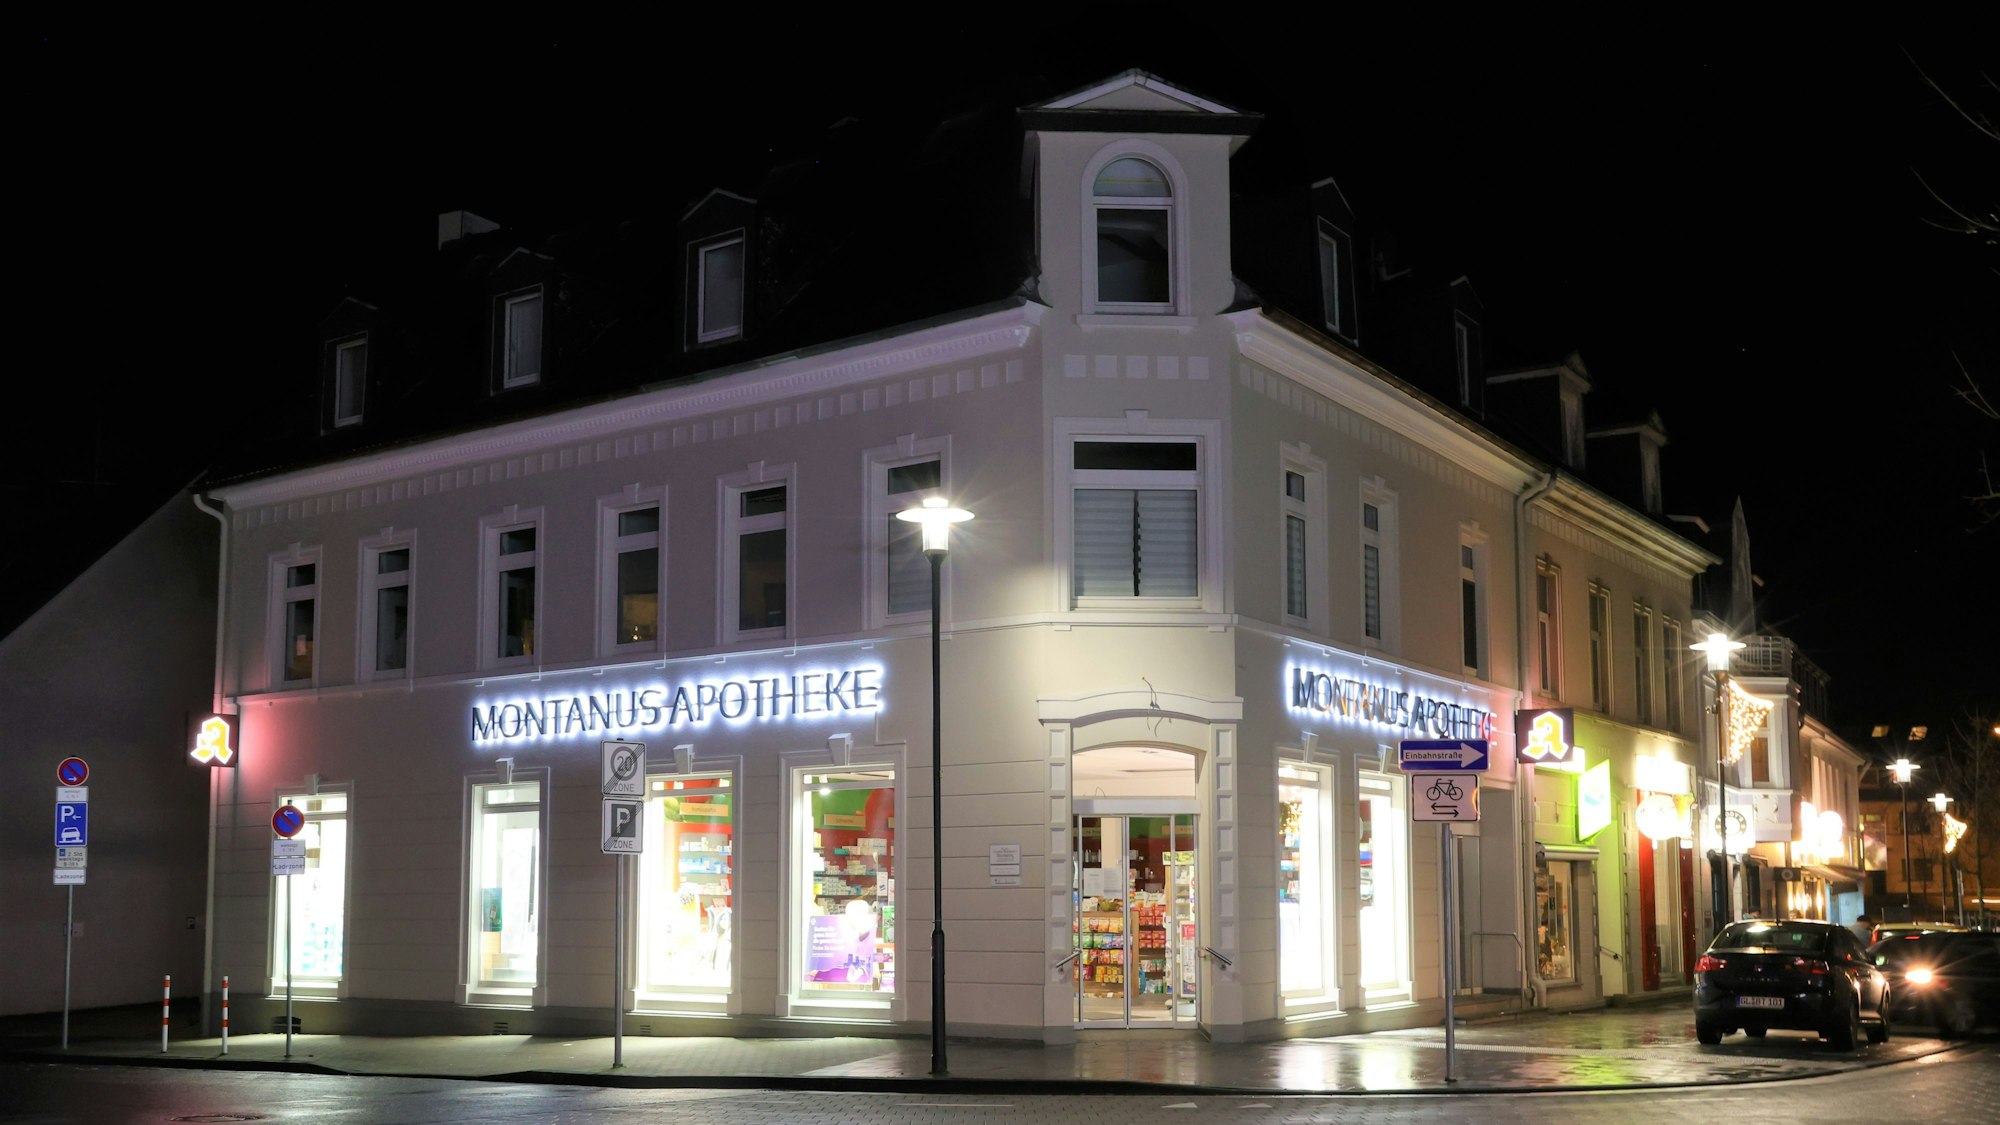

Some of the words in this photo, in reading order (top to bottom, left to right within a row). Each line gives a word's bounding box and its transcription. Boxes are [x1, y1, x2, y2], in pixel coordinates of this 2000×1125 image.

[472, 690, 661, 741] MONTANUS
[669, 669, 878, 724] APOTHEKE
[1293, 668, 1408, 728] MONTANUS
[617, 755, 633, 771] 20
[1405, 751, 1463, 760] Einbahnstraße
[613, 782, 634, 792] ZONE
[61, 805, 75, 822] P
[617, 807, 631, 834] P
[613, 839, 633, 849] ZONE
